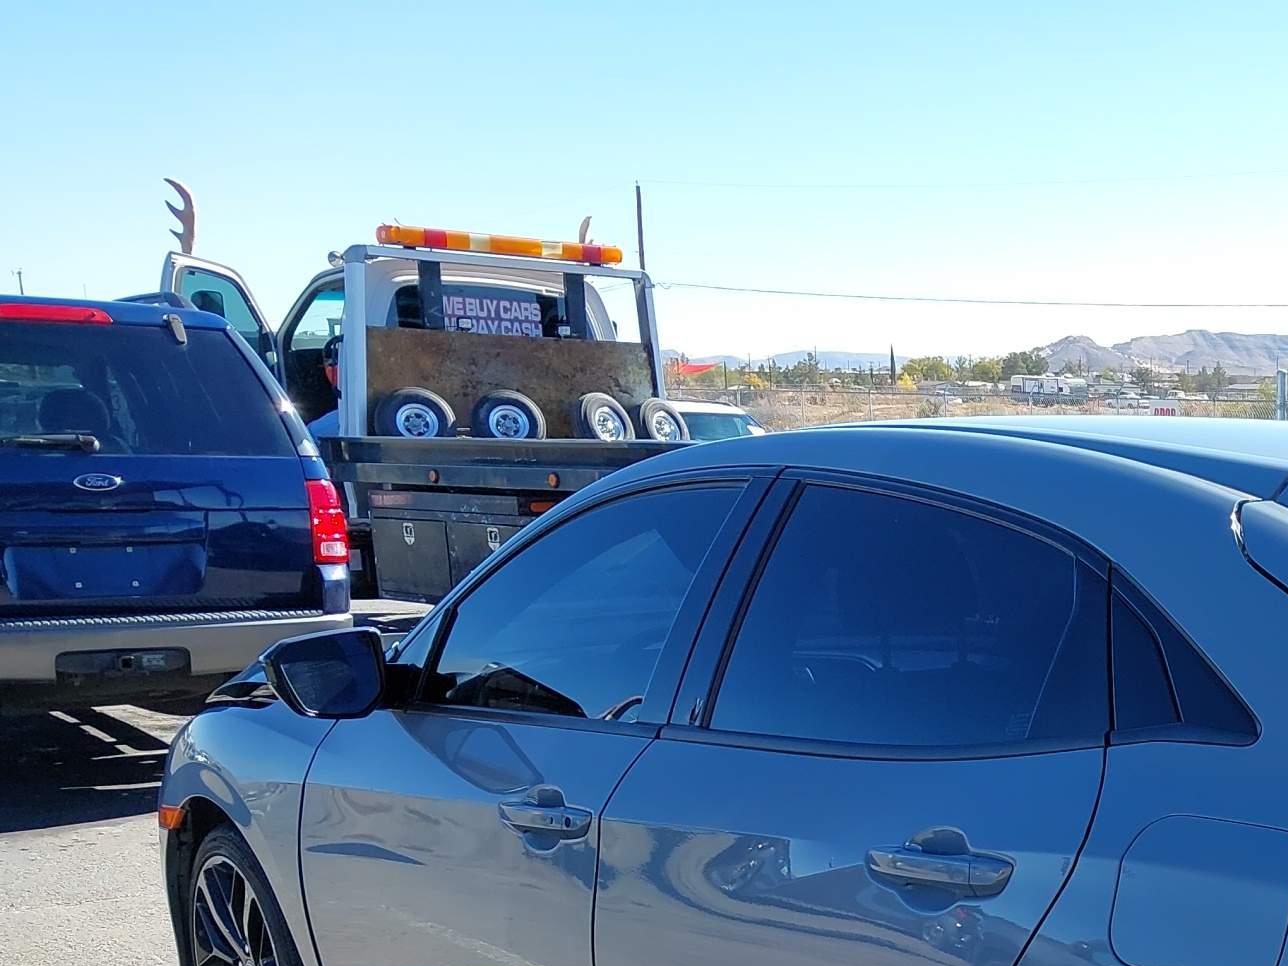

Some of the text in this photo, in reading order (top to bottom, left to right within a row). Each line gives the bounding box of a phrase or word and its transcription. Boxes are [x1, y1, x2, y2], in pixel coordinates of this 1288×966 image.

[465, 297, 498, 318] BUY
[499, 300, 542, 322] CARS
[501, 320, 543, 337] CASH
